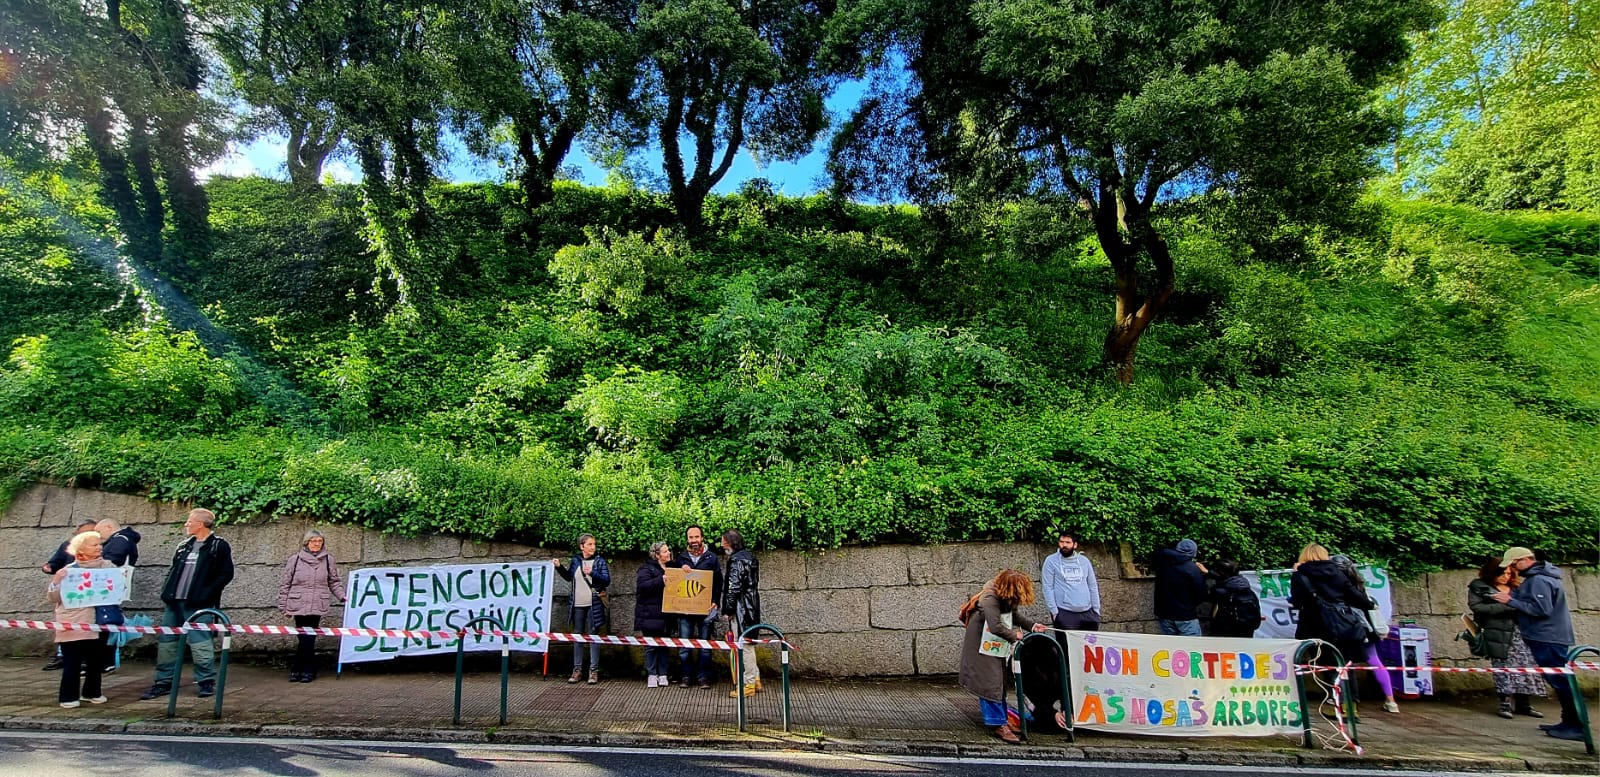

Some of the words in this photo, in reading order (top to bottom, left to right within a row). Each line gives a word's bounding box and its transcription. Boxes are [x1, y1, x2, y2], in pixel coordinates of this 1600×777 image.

[350, 563, 546, 609] ¡ATENCIÓN!
[354, 608, 464, 652] SERES
[1083, 645, 1139, 675] NON
[1151, 649, 1288, 680] CORTEDES
[1077, 693, 1126, 724] AS
[1130, 697, 1209, 727] NOSAS
[1212, 696, 1302, 727] ÁRBORES
